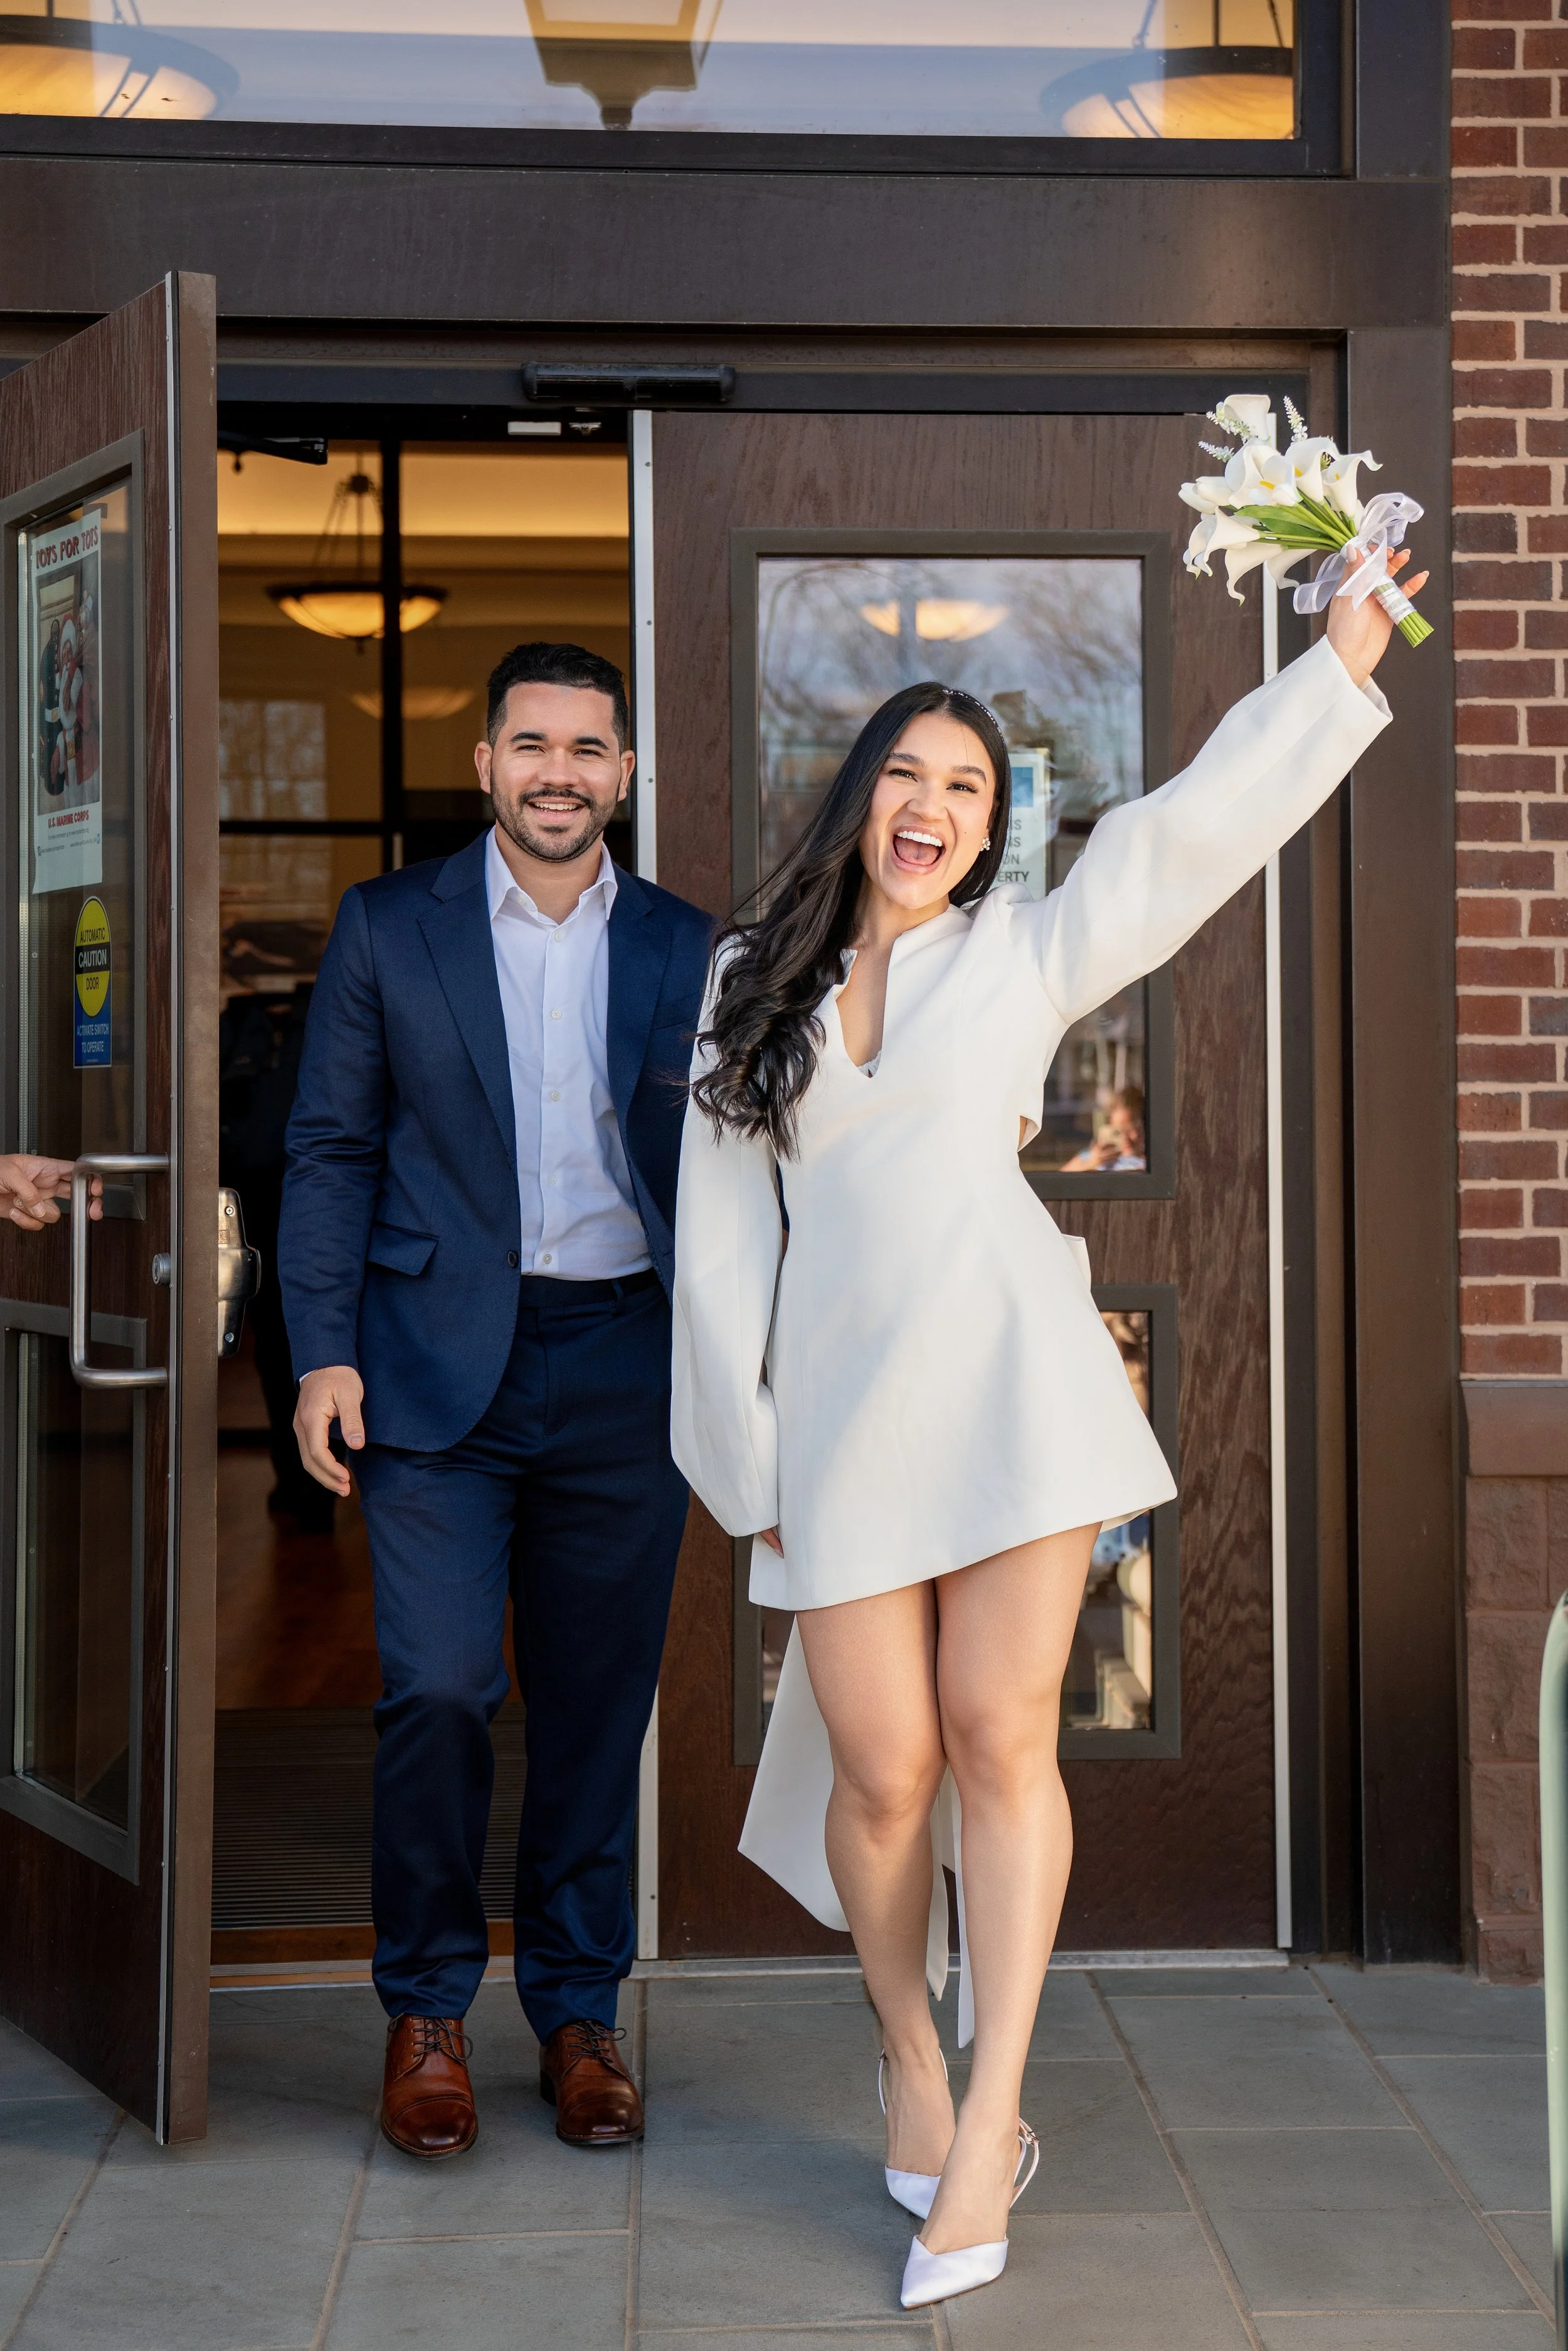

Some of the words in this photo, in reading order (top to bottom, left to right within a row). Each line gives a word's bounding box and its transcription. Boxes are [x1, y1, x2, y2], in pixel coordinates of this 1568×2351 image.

[36, 544, 57, 569] TOYS
[60, 536, 79, 561] FOR
[82, 525, 98, 551] TOTS
[56, 813, 73, 827] MARINE
[74, 810, 89, 823] CORPS
[997, 871, 1029, 882] ERTY
[80, 928, 105, 942] AUTOMATIC
[78, 949, 107, 968] CAUTION
[86, 977, 99, 990] DOOR
[77, 1024, 94, 1037] ACTIVATE
[95, 1024, 109, 1035] SWITCH
[82, 1042, 87, 1053] TO
[87, 1041, 104, 1053] OPERATE
